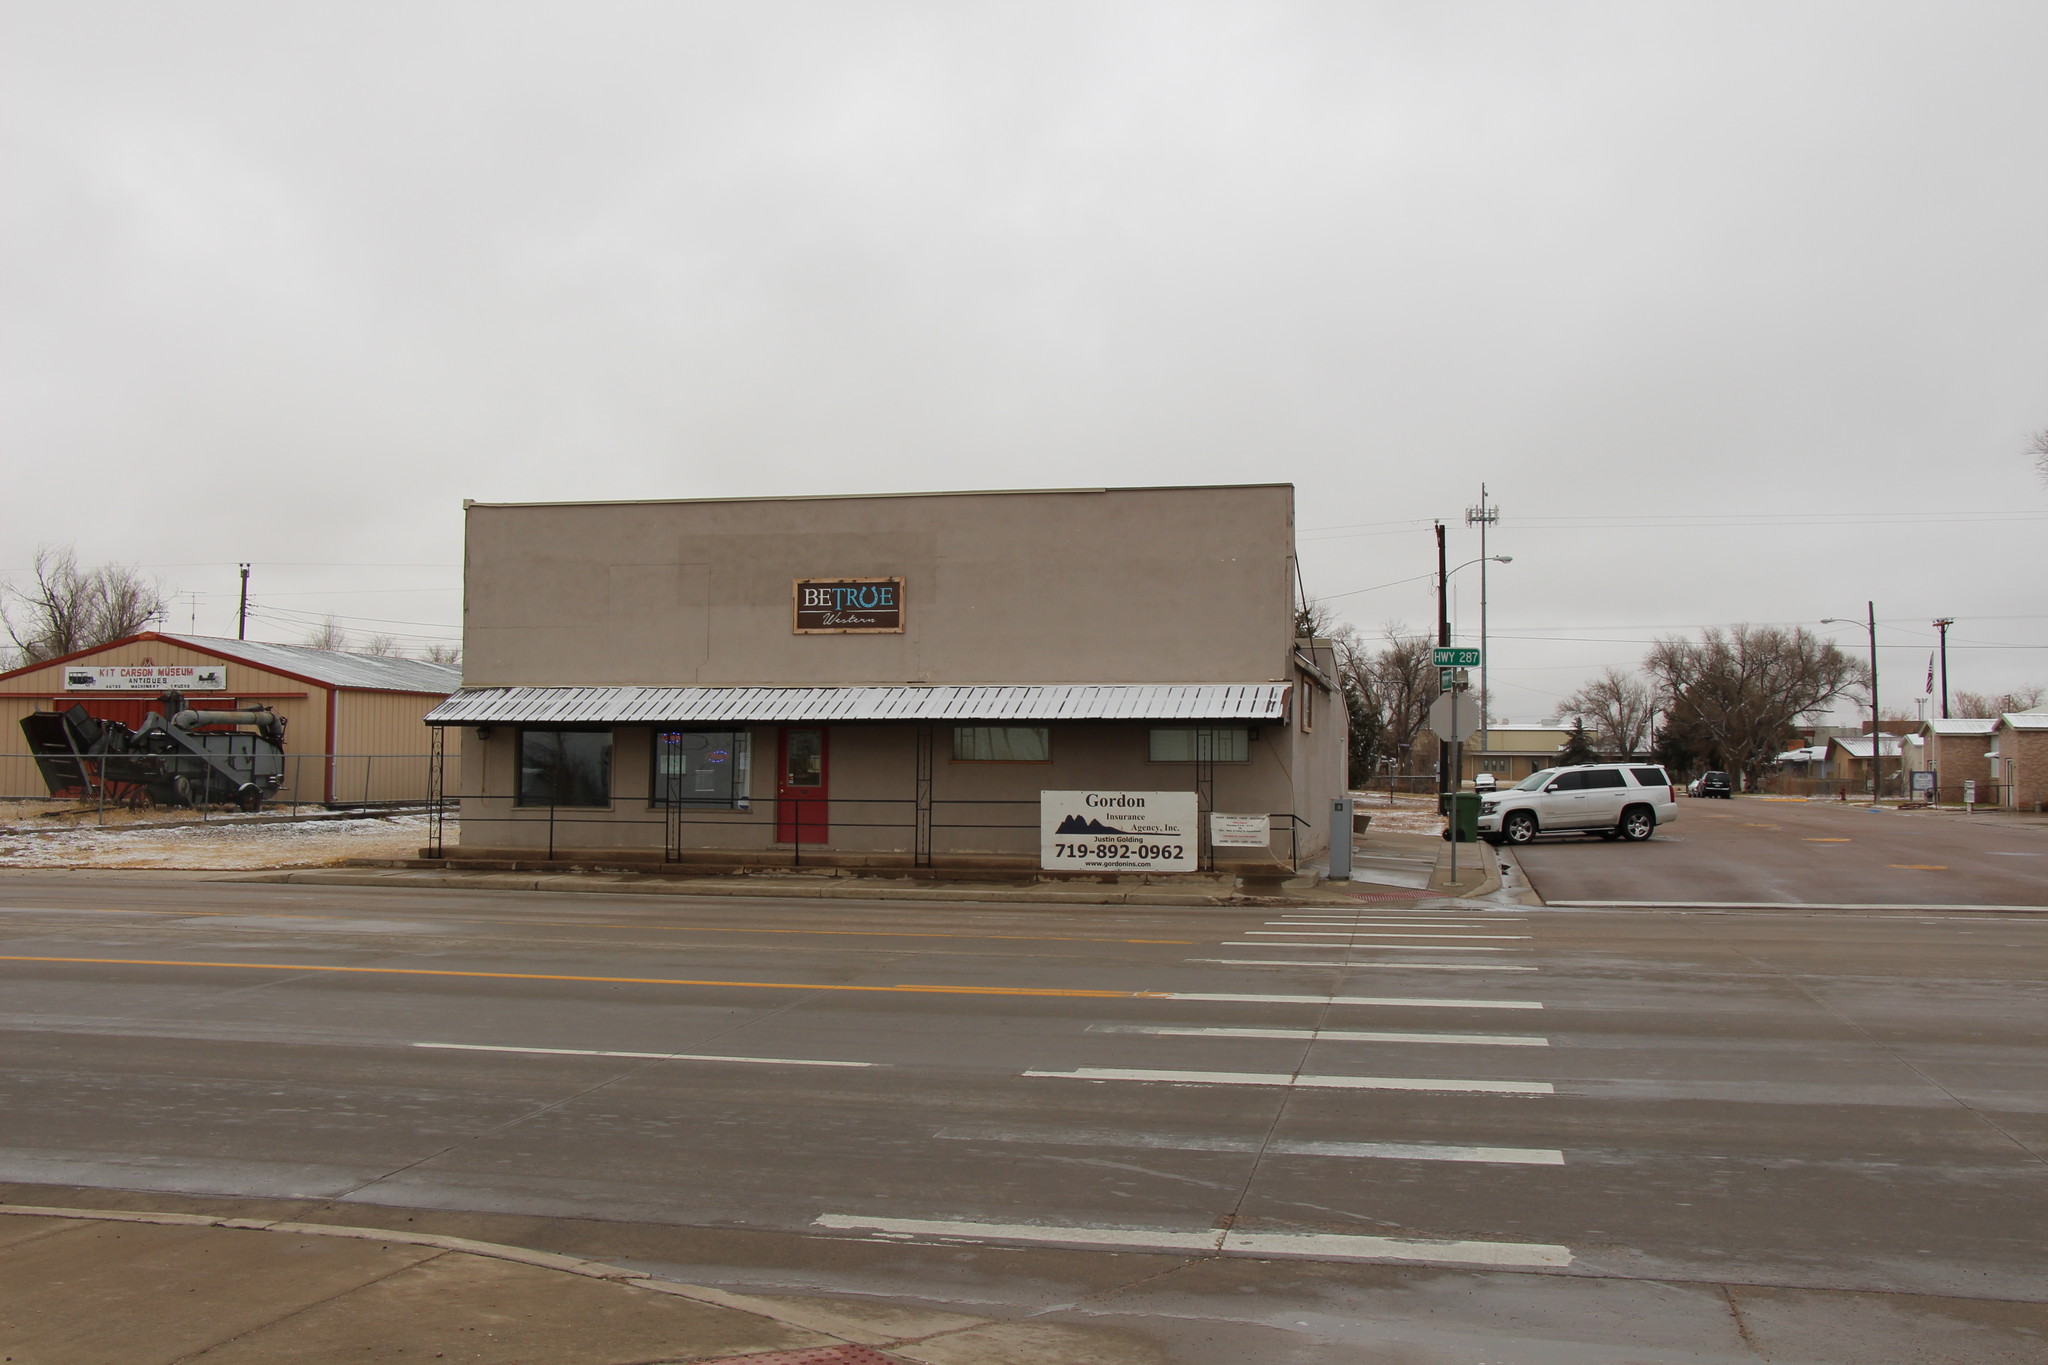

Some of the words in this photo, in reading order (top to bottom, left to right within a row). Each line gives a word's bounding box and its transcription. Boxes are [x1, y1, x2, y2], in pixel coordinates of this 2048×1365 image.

[822, 611, 876, 625] Western
[1434, 651, 1455, 663] HWY
[1459, 651, 1479, 663] 287
[99, 668, 116, 677] KIT
[120, 668, 154, 677] CARSON
[158, 667, 194, 677] MUSEUM
[1085, 793, 1146, 808] Gordon
[1106, 812, 1146, 821] Insurance
[1130, 824, 1163, 834] Agency,
[1164, 824, 1180, 832] Inc.
[1116, 836, 1144, 844] Golding
[1055, 844, 1184, 860] 719-892-0962
[1085, 860, 1152, 868] www.gordonins.com
